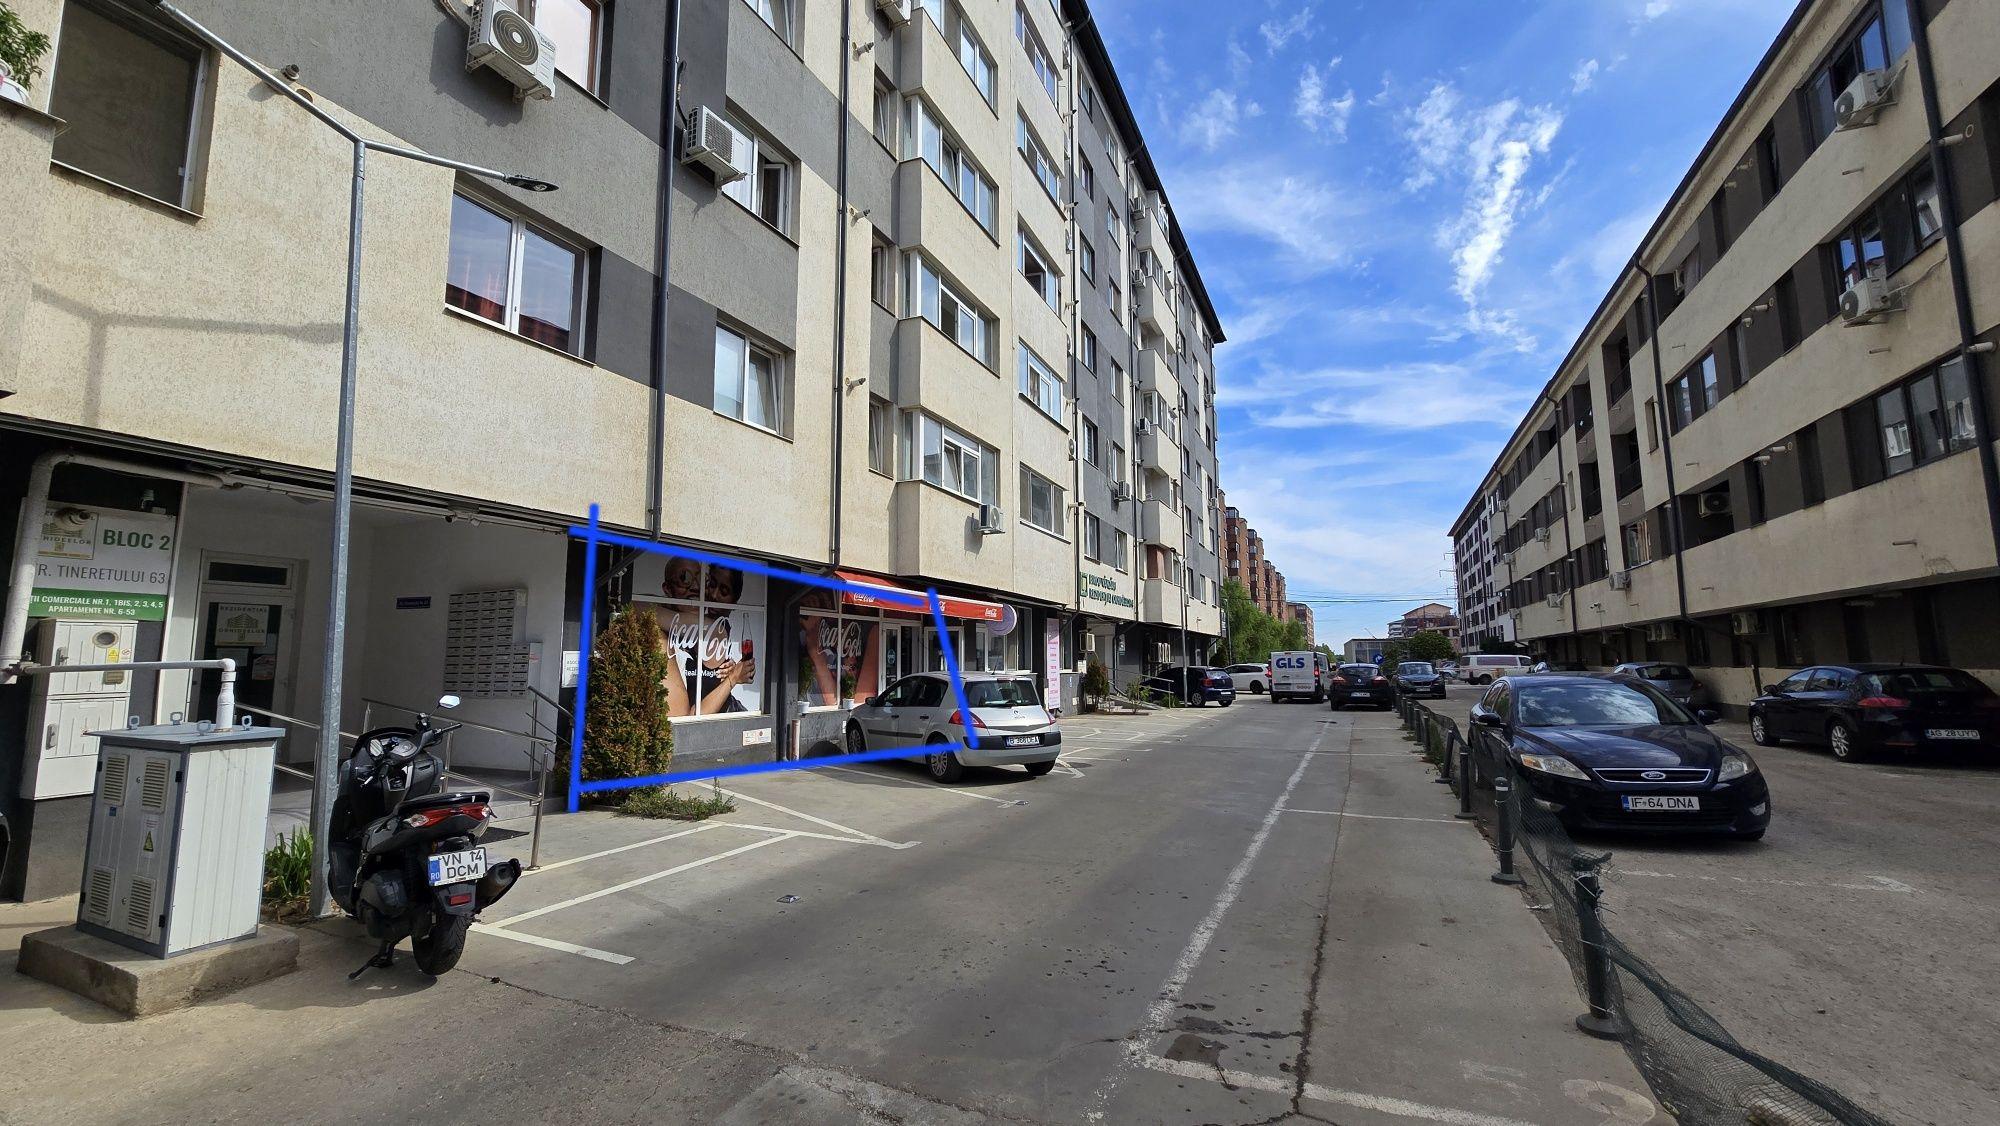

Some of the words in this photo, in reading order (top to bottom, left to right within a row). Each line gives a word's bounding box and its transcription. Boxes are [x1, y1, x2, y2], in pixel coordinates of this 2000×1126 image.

[103, 529, 154, 549] BLOC
[158, 535, 171, 551] 2
[57, 564, 145, 583] TINERETULUI
[149, 572, 166, 584] 63
[41, 595, 91, 605] COMERCIALE
[114, 599, 133, 607] 1BIS,
[134, 600, 141, 608] 2,
[142, 600, 150, 608] 3,
[150, 601, 158, 609] 4,
[48, 605, 103, 614] APARTAMENTE
[117, 608, 136, 616] 6-53
[1275, 657, 1306, 669] GLS
[1631, 797, 1643, 808] IF
[1647, 797, 1664, 808] 64
[1666, 797, 1695, 809] DNA
[442, 853, 462, 867] VN
[447, 863, 479, 879] DCM
